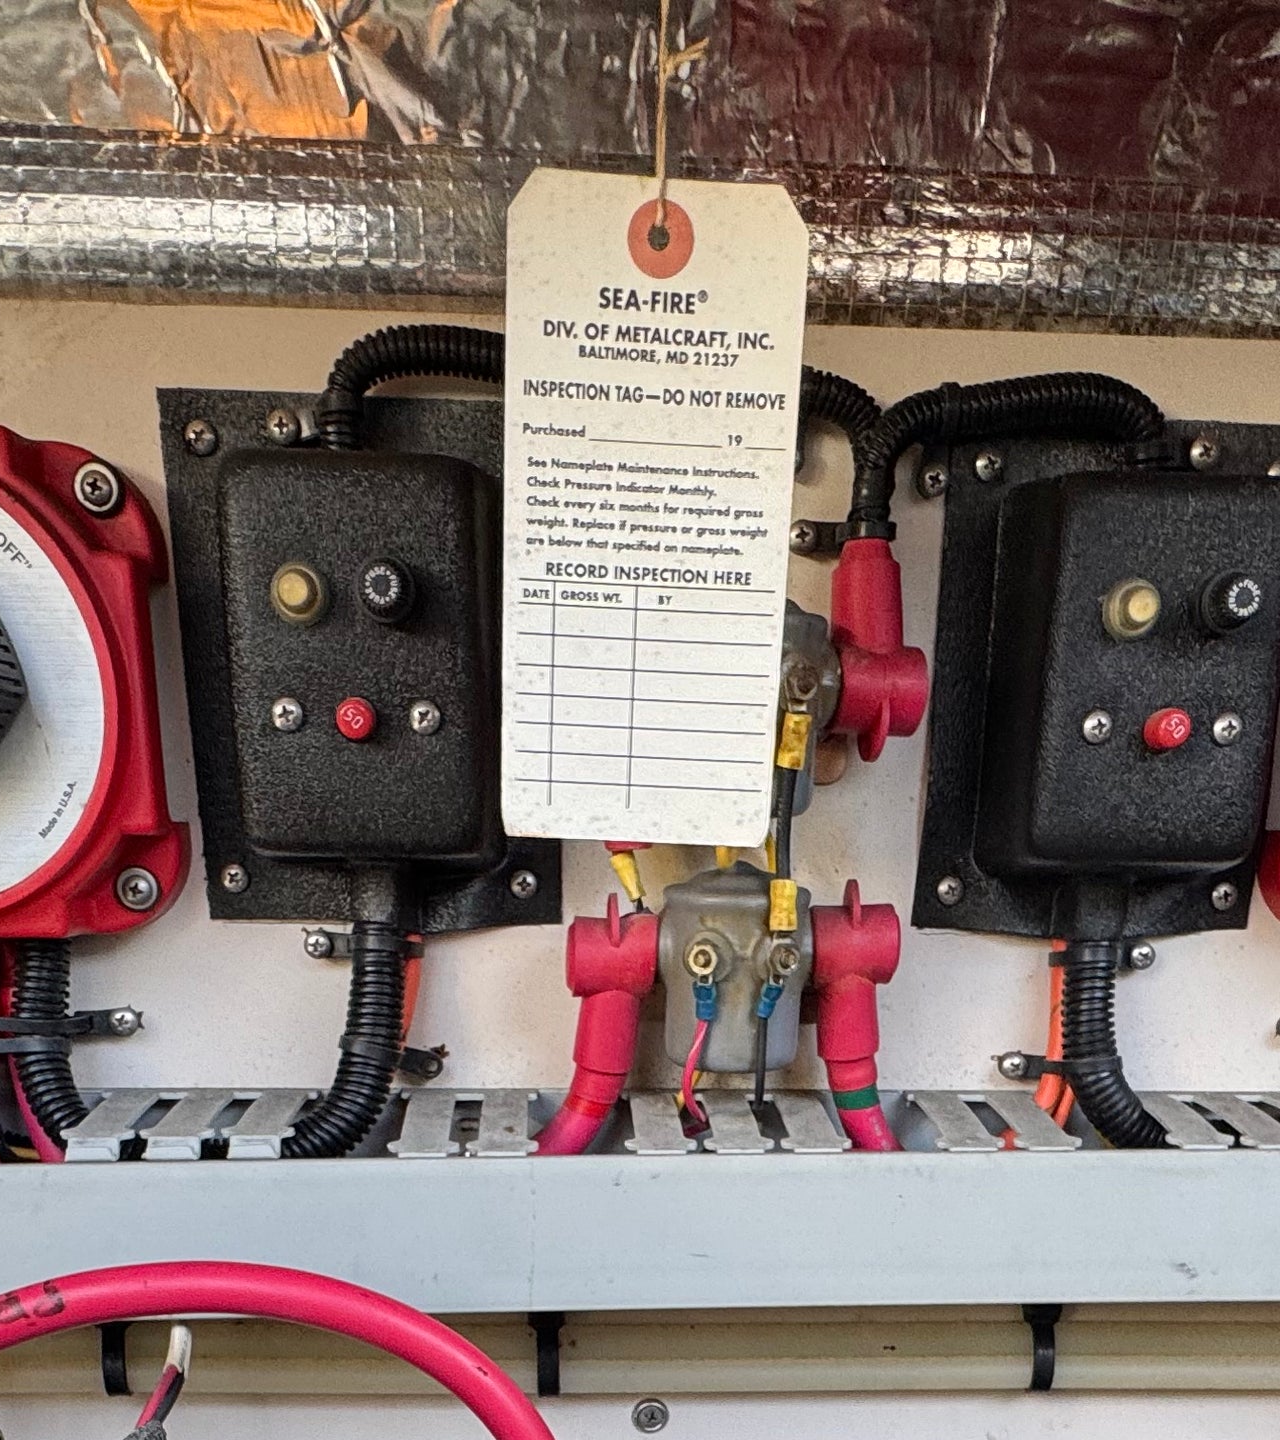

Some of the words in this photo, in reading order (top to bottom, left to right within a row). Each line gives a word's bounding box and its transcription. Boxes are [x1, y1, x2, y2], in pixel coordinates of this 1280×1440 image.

[542, 319, 578, 339] DIV.
[583, 321, 609, 341] OF
[614, 324, 730, 350] METALCRAFT,
[736, 331, 775, 350] INC.
[577, 344, 661, 364] BALTIMORE,
[664, 349, 689, 365] MD
[692, 351, 739, 367] 21237
[522, 378, 610, 401] INSPECTION
[688, 389, 722, 408] NOT
[725, 391, 786, 410] REMOVE
[521, 421, 586, 438] Purchased
[727, 433, 743, 447] 19
[526, 455, 547, 468] See
[550, 457, 614, 473] Nameplate
[616, 461, 689, 476] Maintenance
[691, 465, 760, 480] Instructions.
[525, 475, 560, 489] Check
[563, 477, 612, 491] Pressure
[615, 481, 665, 494] Indicator
[667, 483, 717, 500] Monthly.
[525, 494, 560, 508] Check
[562, 499, 596, 513] every
[598, 498, 616, 511] six
[618, 501, 660, 513] months
[662, 502, 680, 514] for
[682, 505, 731, 519] required
[732, 508, 764, 521] gross
[525, 514, 568, 530] weight.
[571, 517, 615, 532] Replace
[618, 519, 627, 531] if
[629, 522, 678, 534] pressure
[680, 525, 693, 534] or
[695, 526, 726, 538] gross
[728, 526, 768, 540] weight
[525, 536, 545, 546] are
[547, 535, 583, 548] below
[585, 537, 609, 549] that
[611, 539, 661, 553] specified
[663, 544, 678, 553] on
[680, 544, 744, 558] nameplate.
[545, 561, 608, 579] RECORD
[613, 565, 708, 584] INSPECTION
[713, 569, 752, 586] HERE
[522, 587, 550, 600] DATE
[559, 589, 599, 602] GROSS
[601, 591, 622, 604] WT.
[657, 594, 673, 606] BY
[342, 708, 364, 729] 50
[1165, 717, 1186, 739] 50
[38, 816, 58, 839] Made
[53, 807, 65, 818] in
